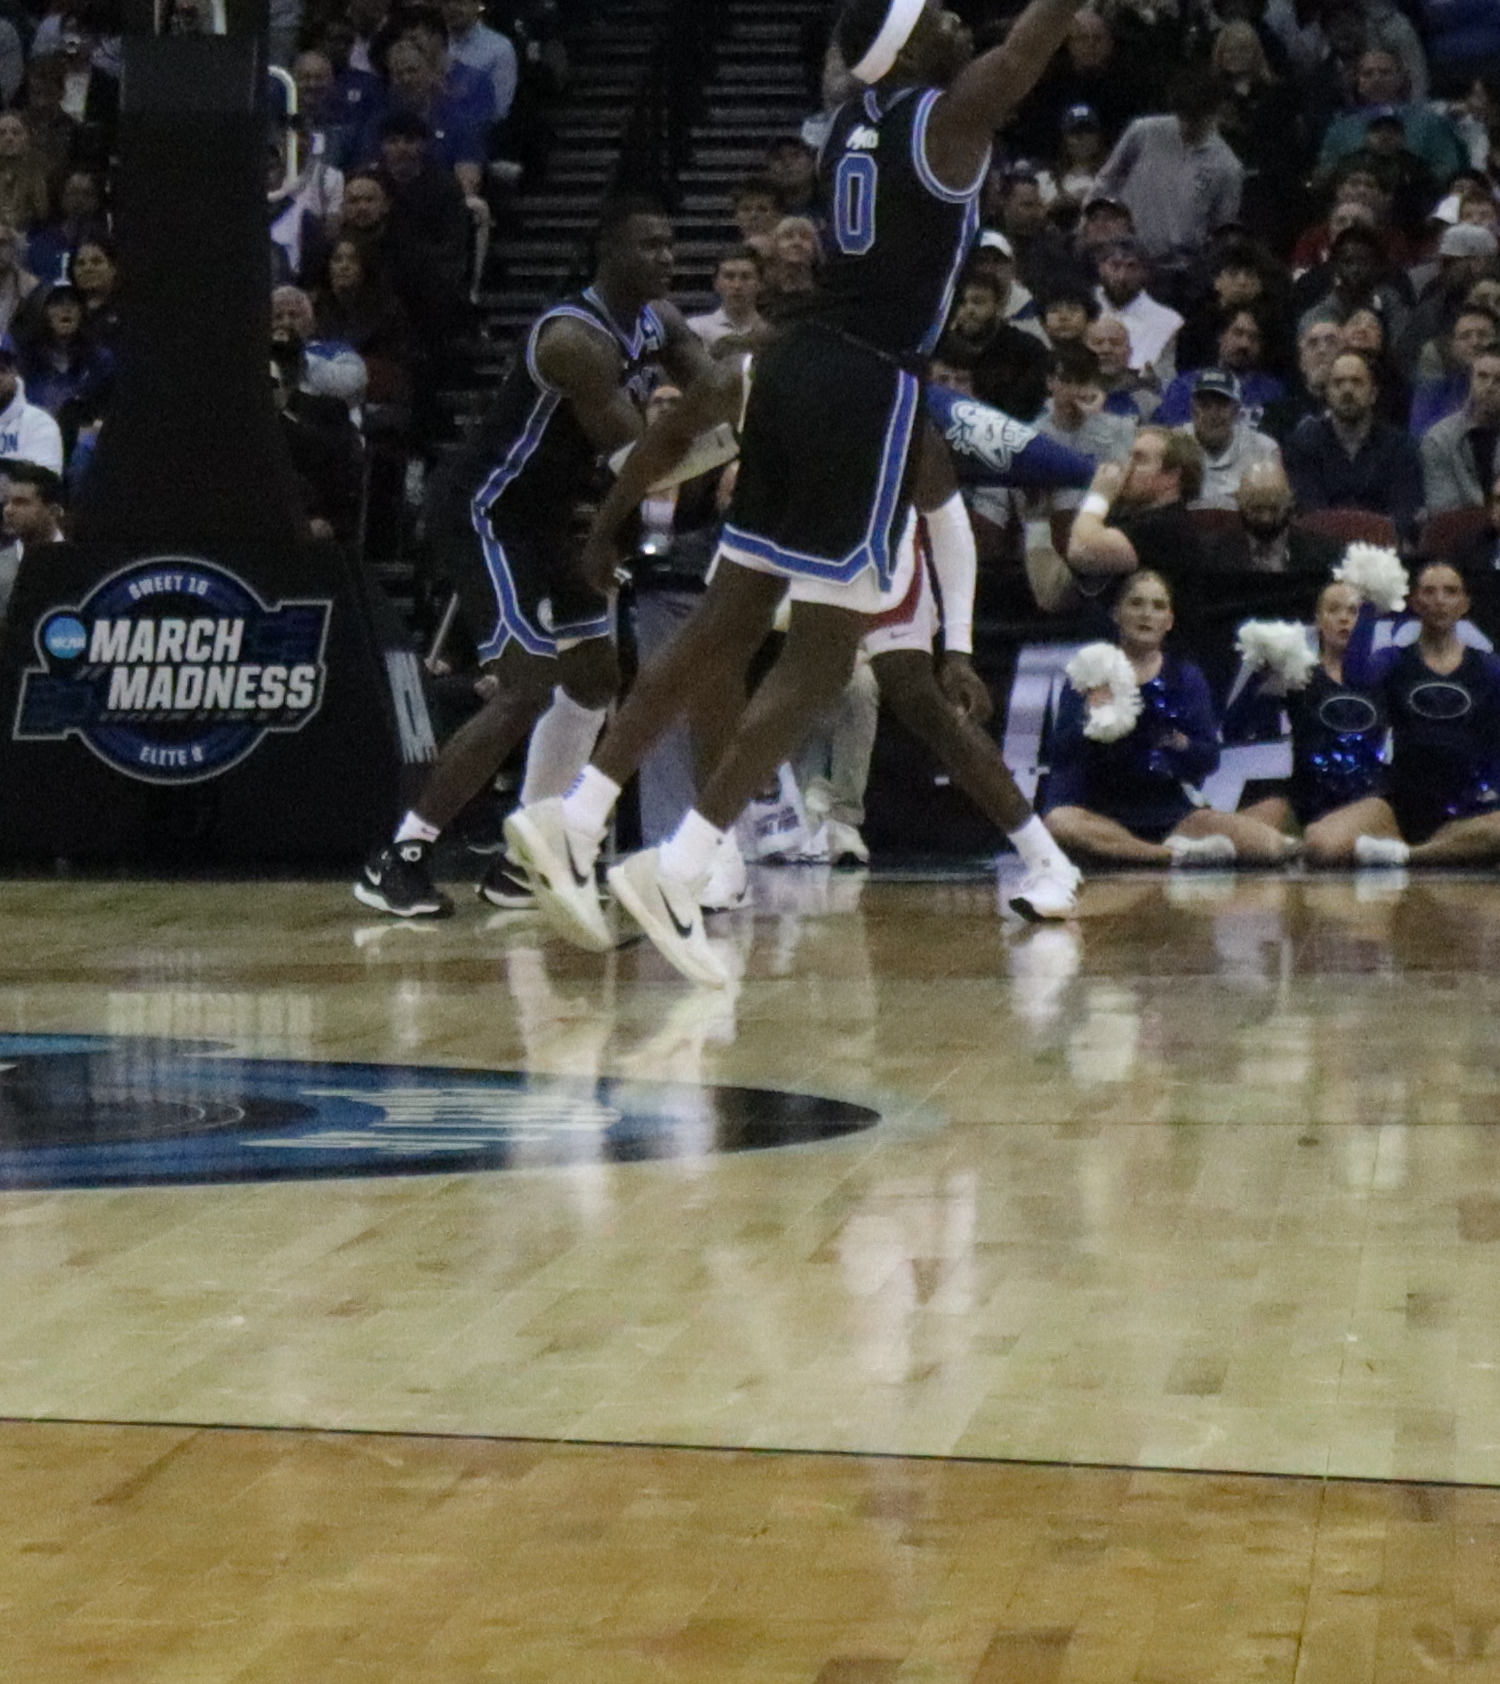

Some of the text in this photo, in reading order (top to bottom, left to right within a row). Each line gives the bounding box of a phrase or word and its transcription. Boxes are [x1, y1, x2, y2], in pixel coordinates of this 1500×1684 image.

[834, 152, 878, 256] 0
[127, 574, 185, 601] SWEET
[88, 618, 245, 664] MARCH
[107, 665, 316, 710] MADNESS
[139, 745, 188, 767] ELITE
